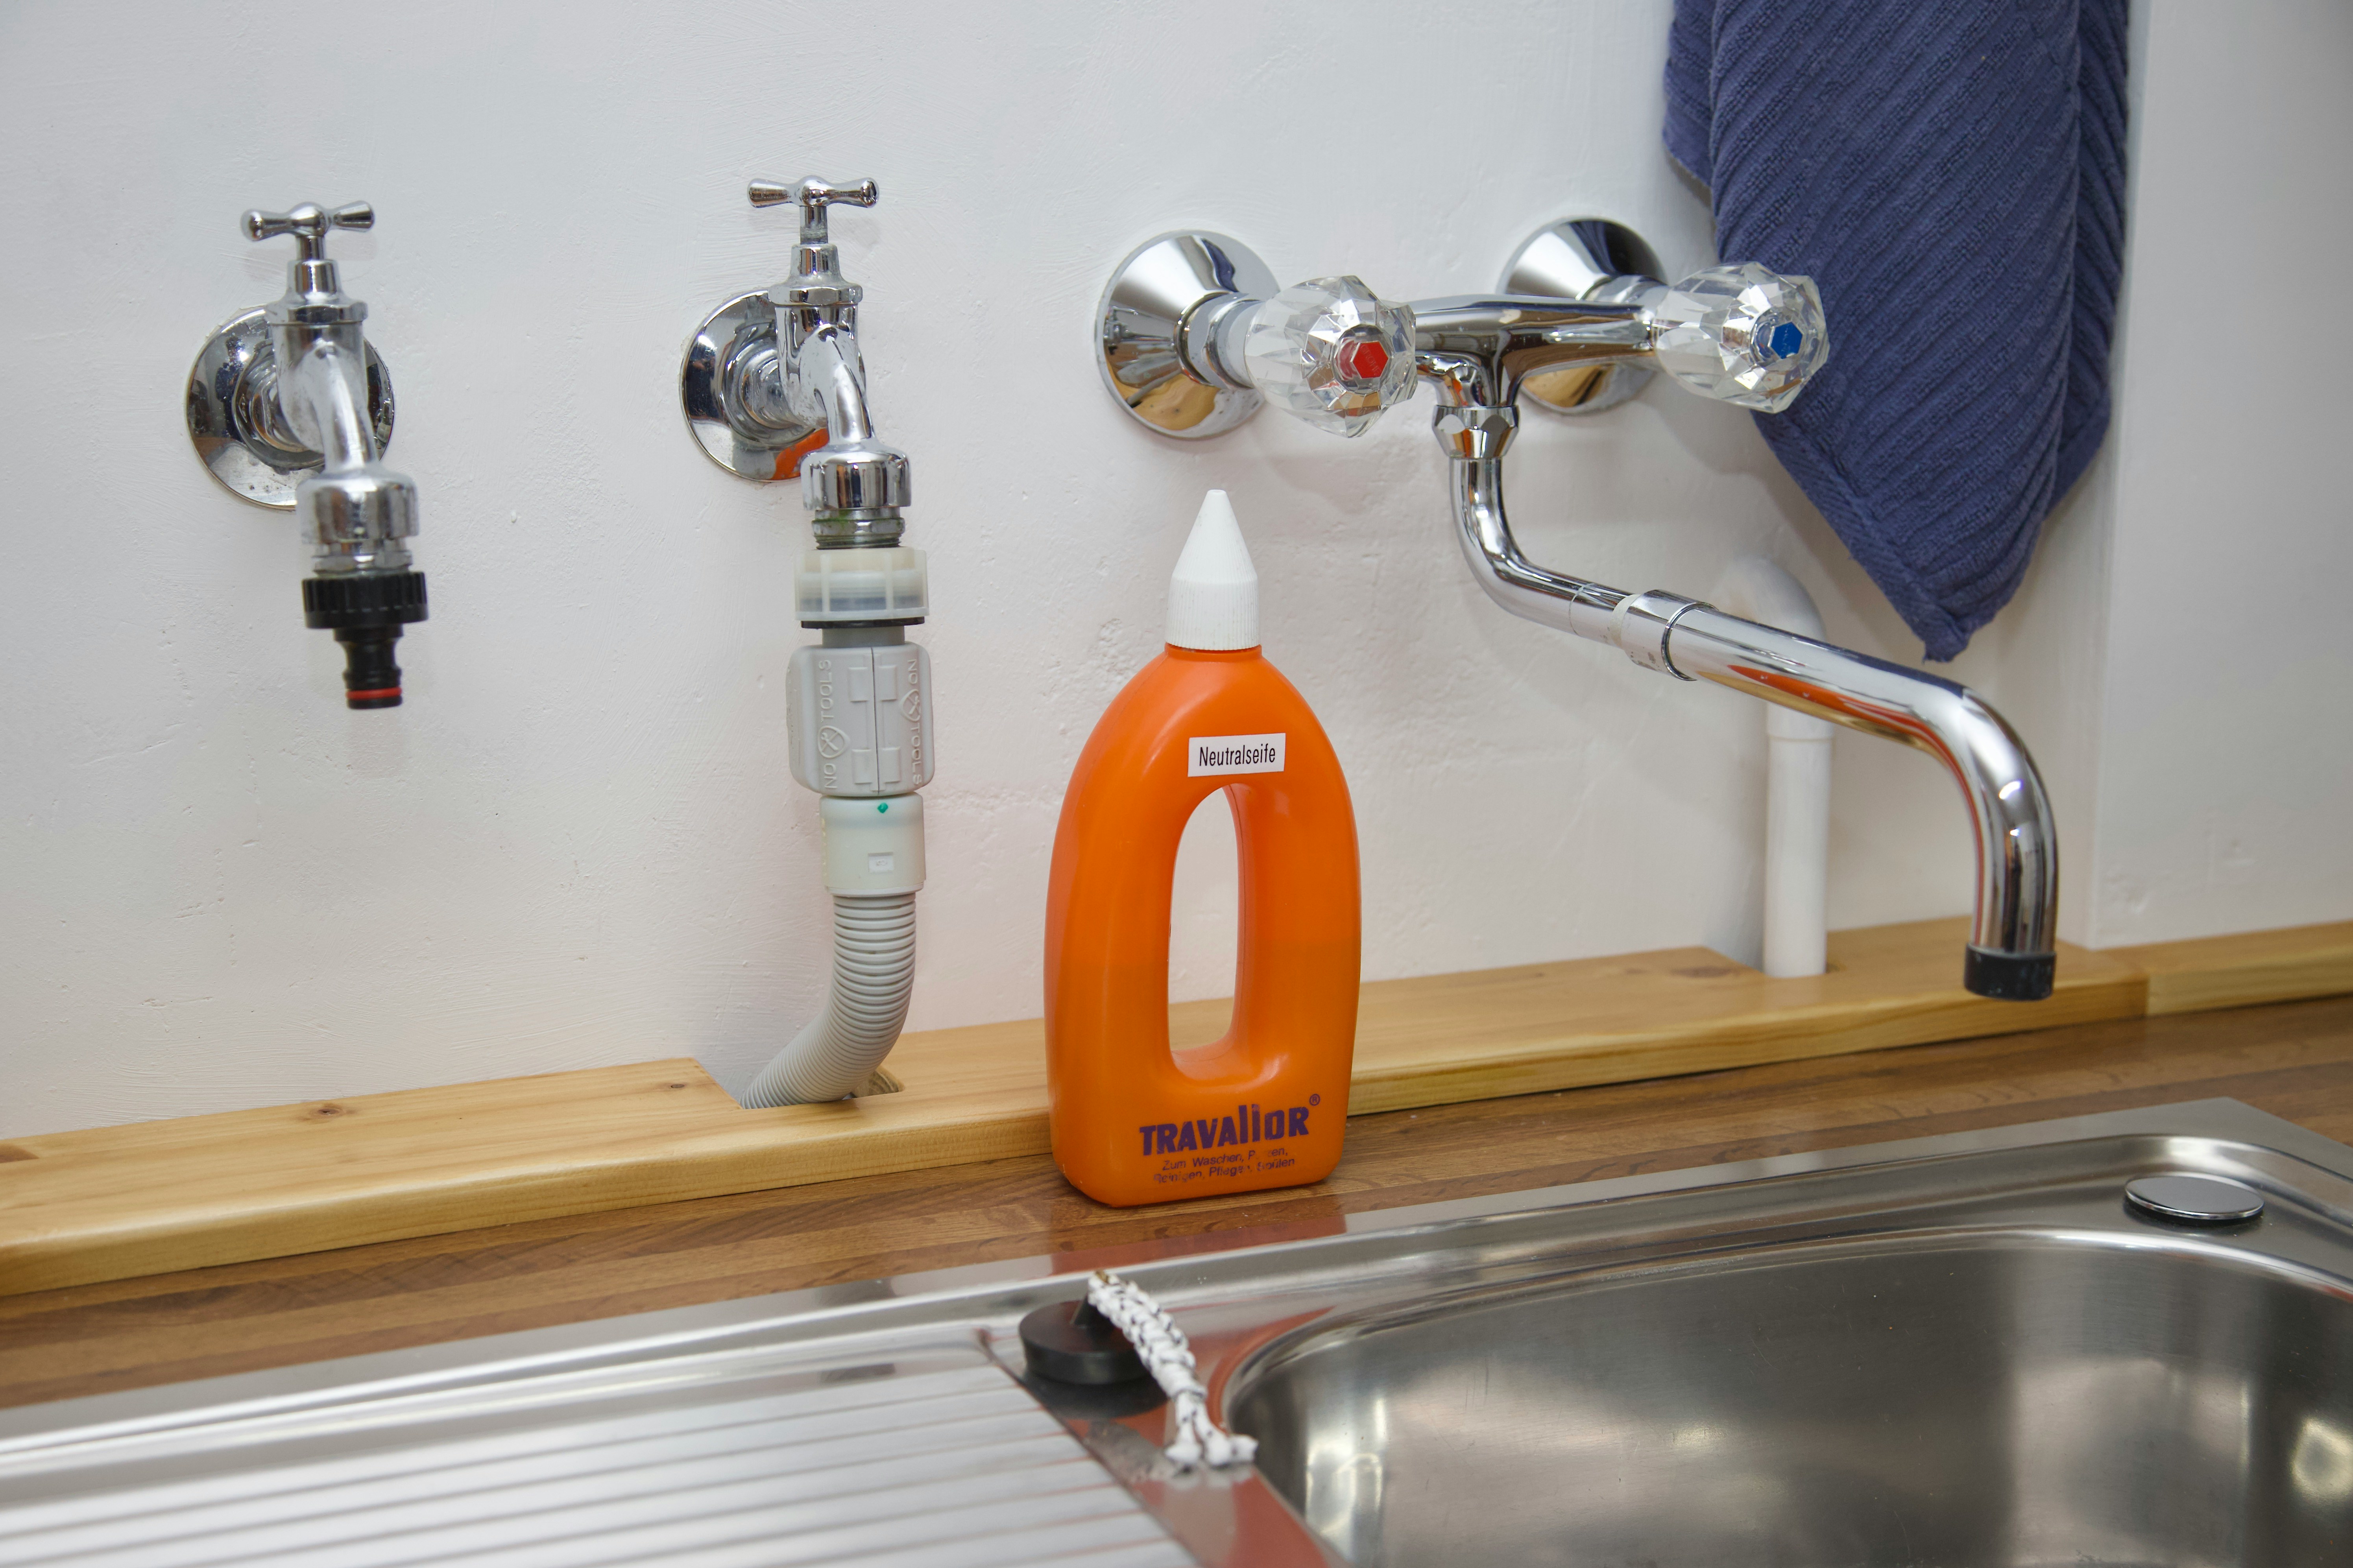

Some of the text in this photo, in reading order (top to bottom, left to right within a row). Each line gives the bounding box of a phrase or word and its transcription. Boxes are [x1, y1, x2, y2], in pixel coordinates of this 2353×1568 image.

[818, 660, 837, 789] NO TOOLS
[907, 659, 922, 785] NO TOOLS
[1199, 743, 1276, 766] Neutralseife
[1162, 1160, 1186, 1171] Zum
[1193, 1153, 1244, 1167] Waschen,
